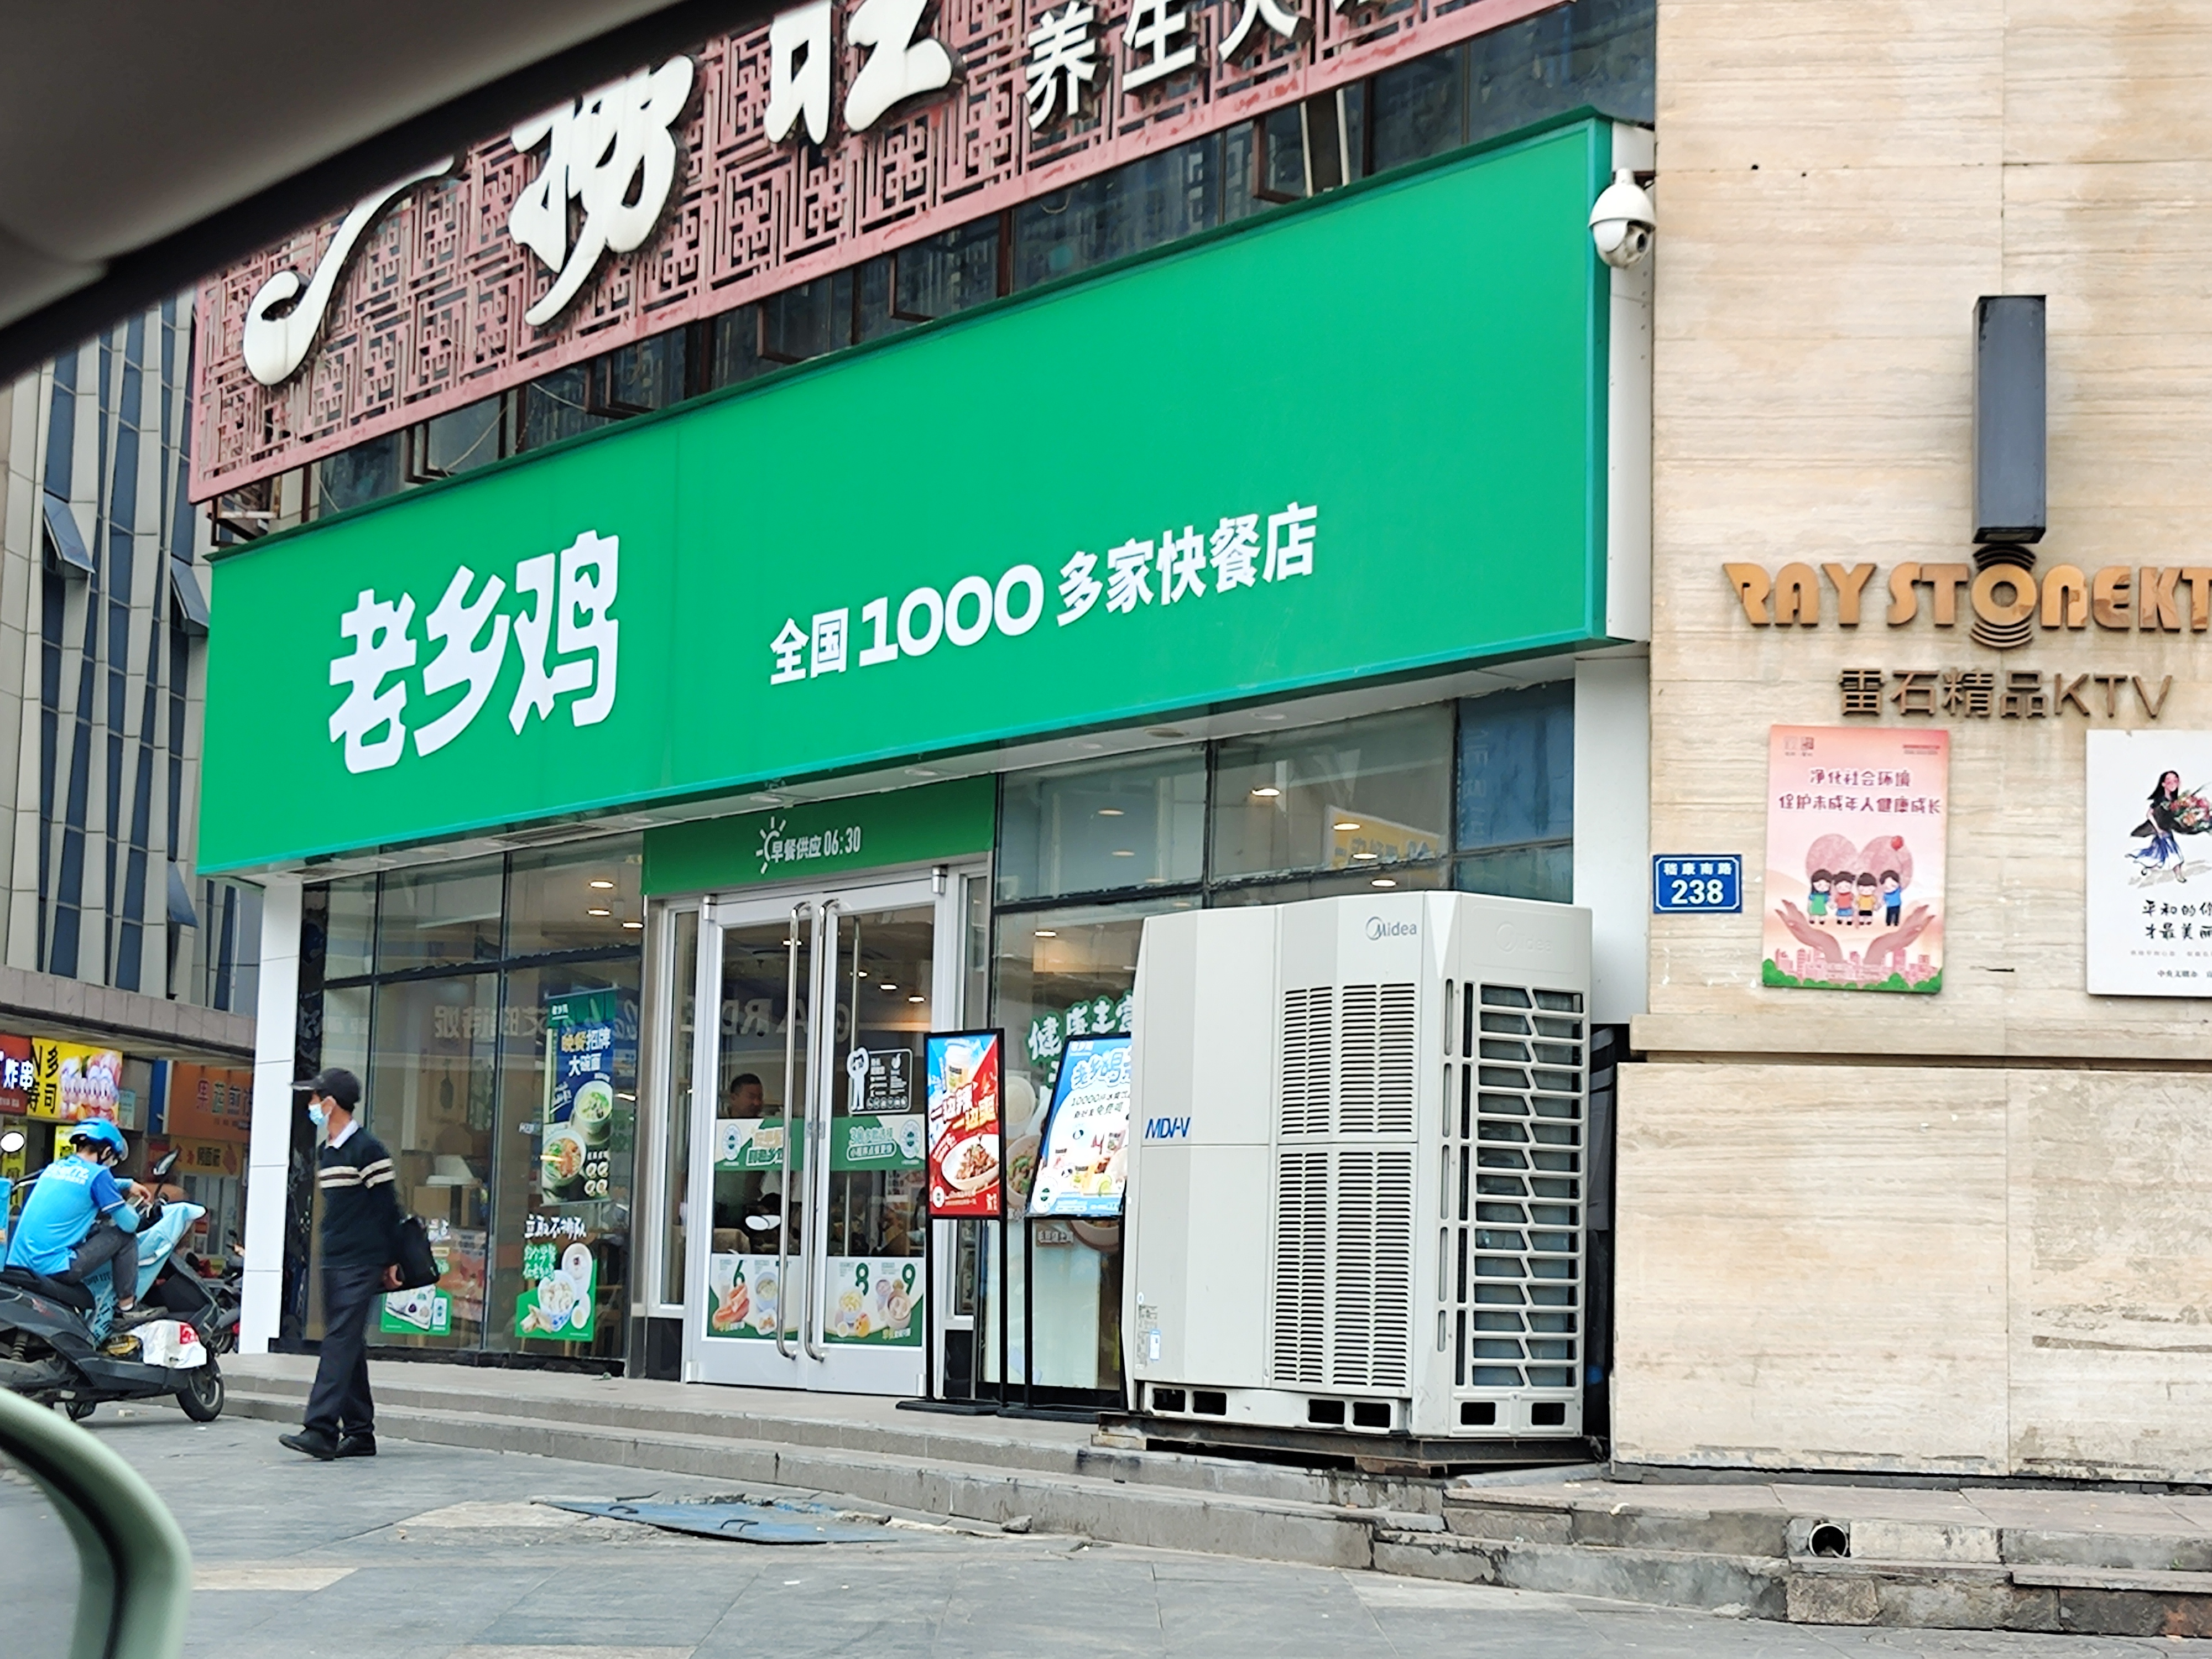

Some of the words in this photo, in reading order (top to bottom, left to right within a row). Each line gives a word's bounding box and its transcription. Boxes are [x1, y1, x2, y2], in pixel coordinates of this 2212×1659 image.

[328, 529, 620, 774] 老乡鸡
[1839, 667, 2173, 719] 雷石精品KTV
[1809, 769, 1911, 787] 净化社会环境
[1778, 793, 1941, 814] 保护未成年人健康成长
[1671, 879, 1724, 905] 238
[1365, 915, 1417, 941] Midea
[0, 1049, 34, 1090] 炸串
[1145, 1117, 1191, 1139] MDV-V
[902, 1263, 916, 1295] 9
